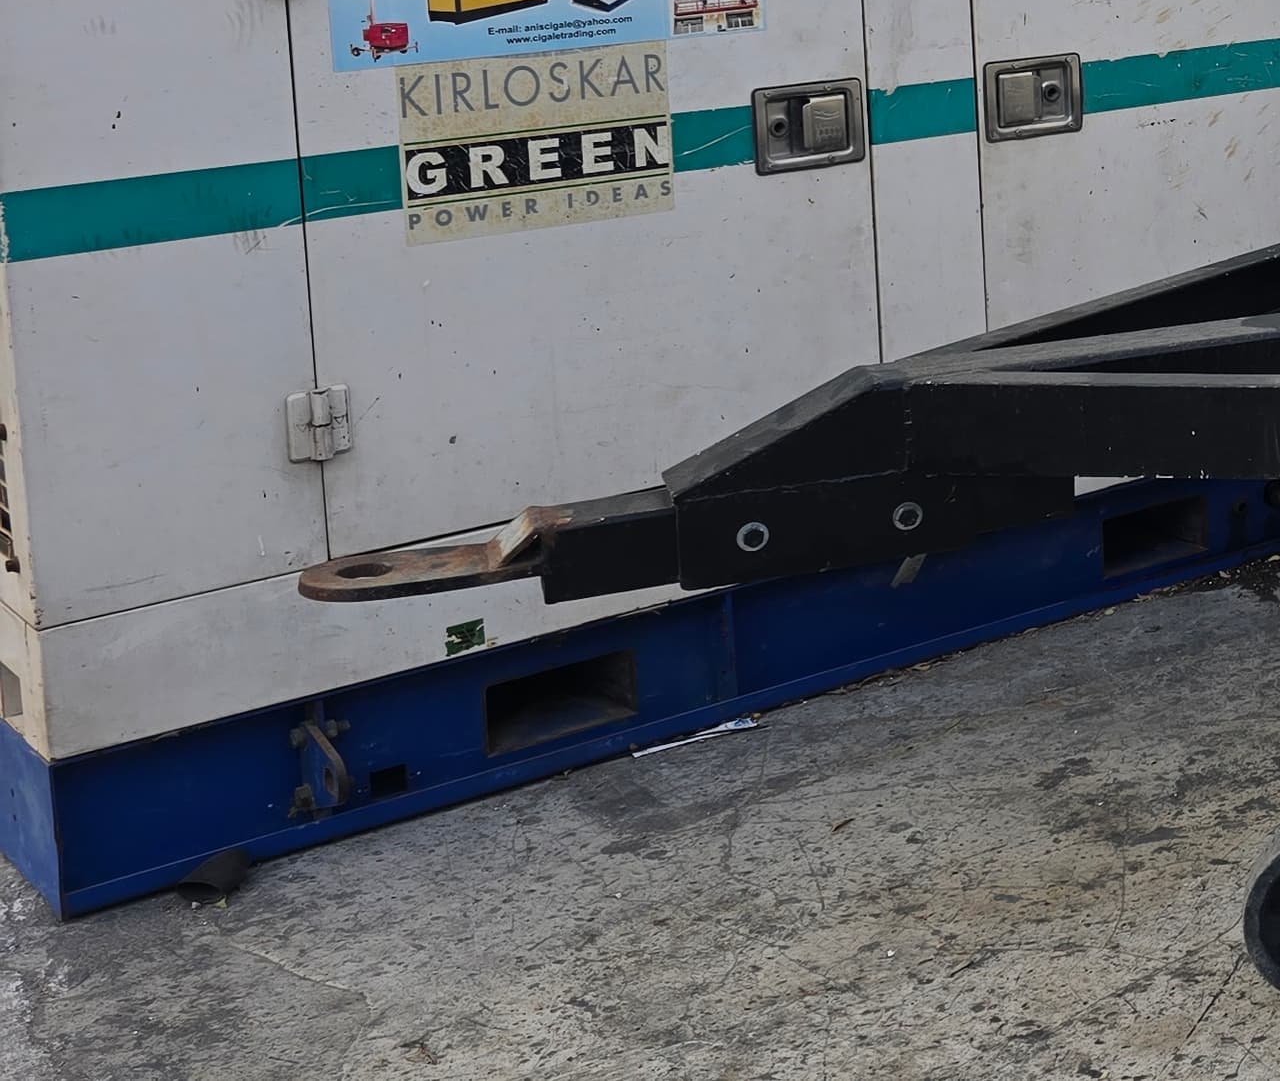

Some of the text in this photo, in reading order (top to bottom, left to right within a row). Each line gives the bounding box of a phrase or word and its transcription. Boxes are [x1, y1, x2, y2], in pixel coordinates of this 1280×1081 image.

[487, 15, 633, 36] E-mail: aniscigale@yahoo.com
[506, 26, 617, 45] www.cigaletrading.com
[399, 53, 666, 119] KIRLOSKAR
[405, 126, 669, 196] GREEN
[408, 181, 673, 231] POWER IDEAS
